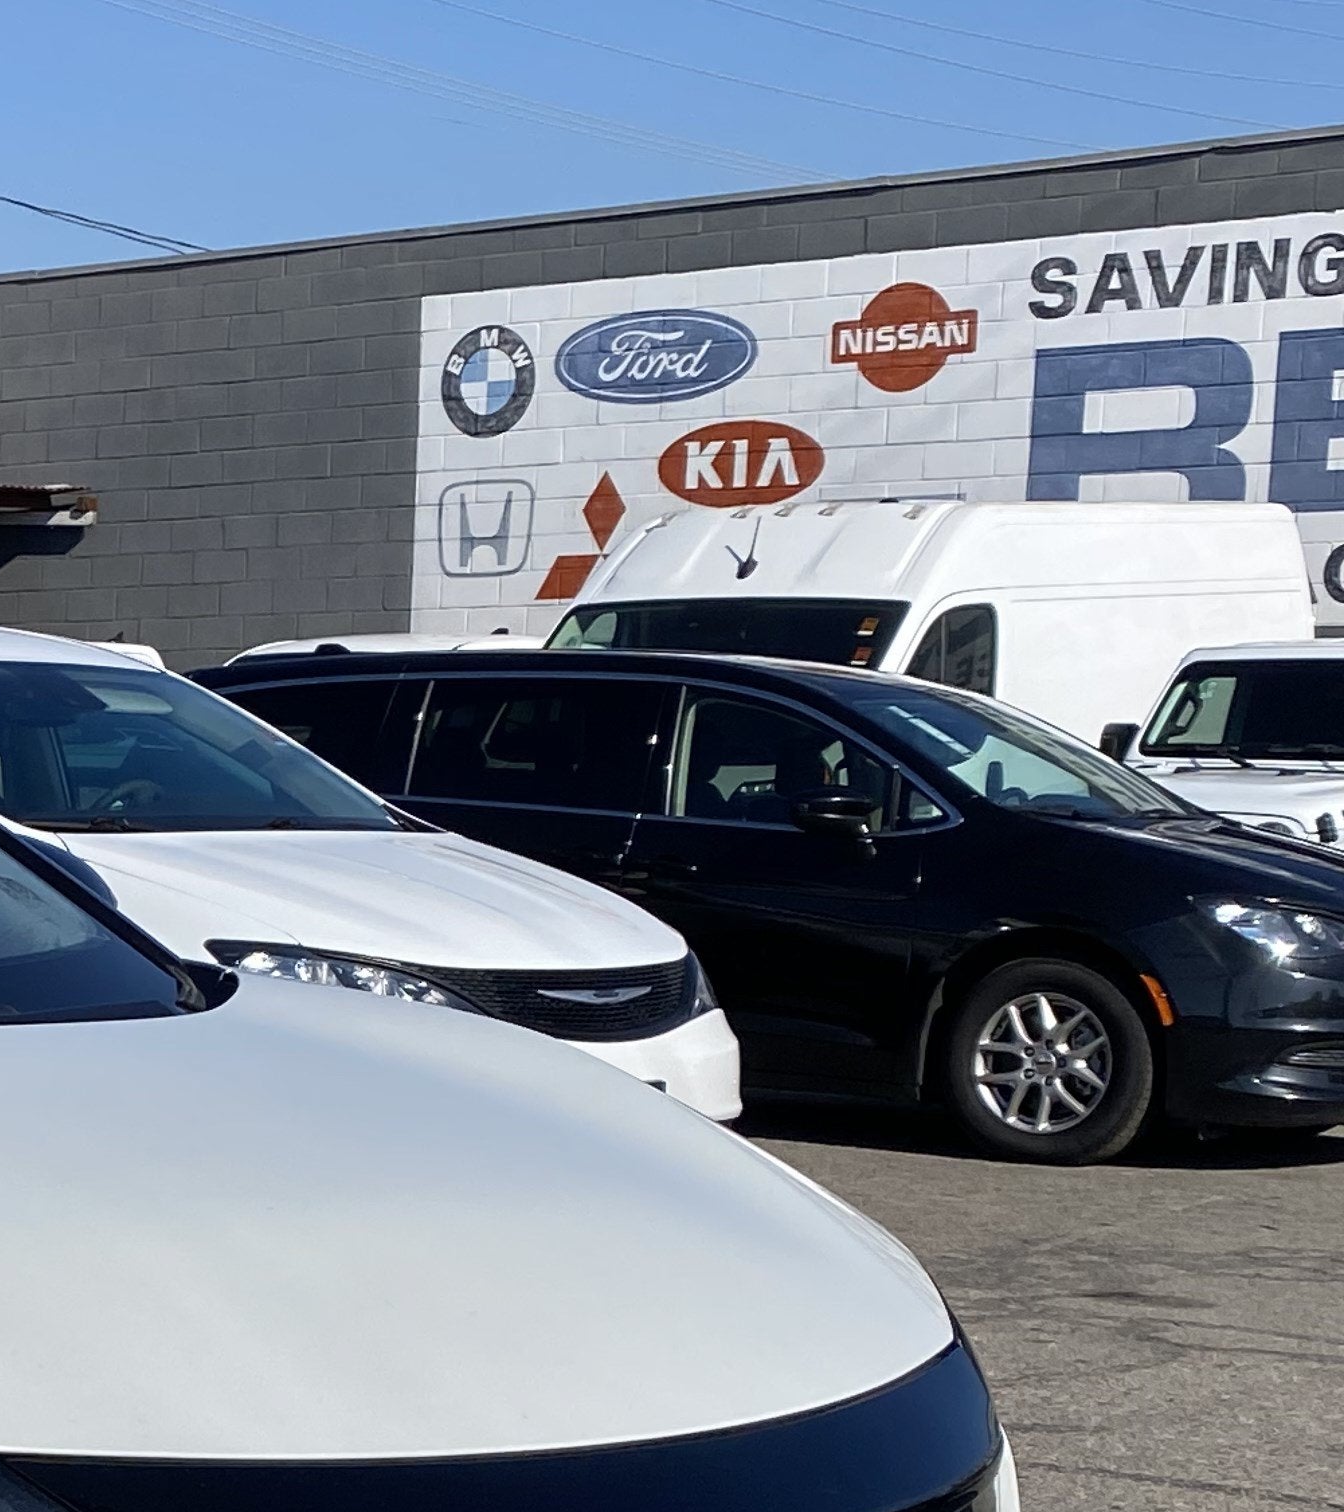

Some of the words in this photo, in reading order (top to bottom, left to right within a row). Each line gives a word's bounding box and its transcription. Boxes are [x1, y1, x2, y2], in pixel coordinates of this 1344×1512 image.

[1028, 232, 1344, 320] SAVING
[446, 328, 532, 376] BMW
[598, 329, 712, 382] Ford
[838, 319, 970, 356] NISSAN
[684, 437, 800, 490] KIA
